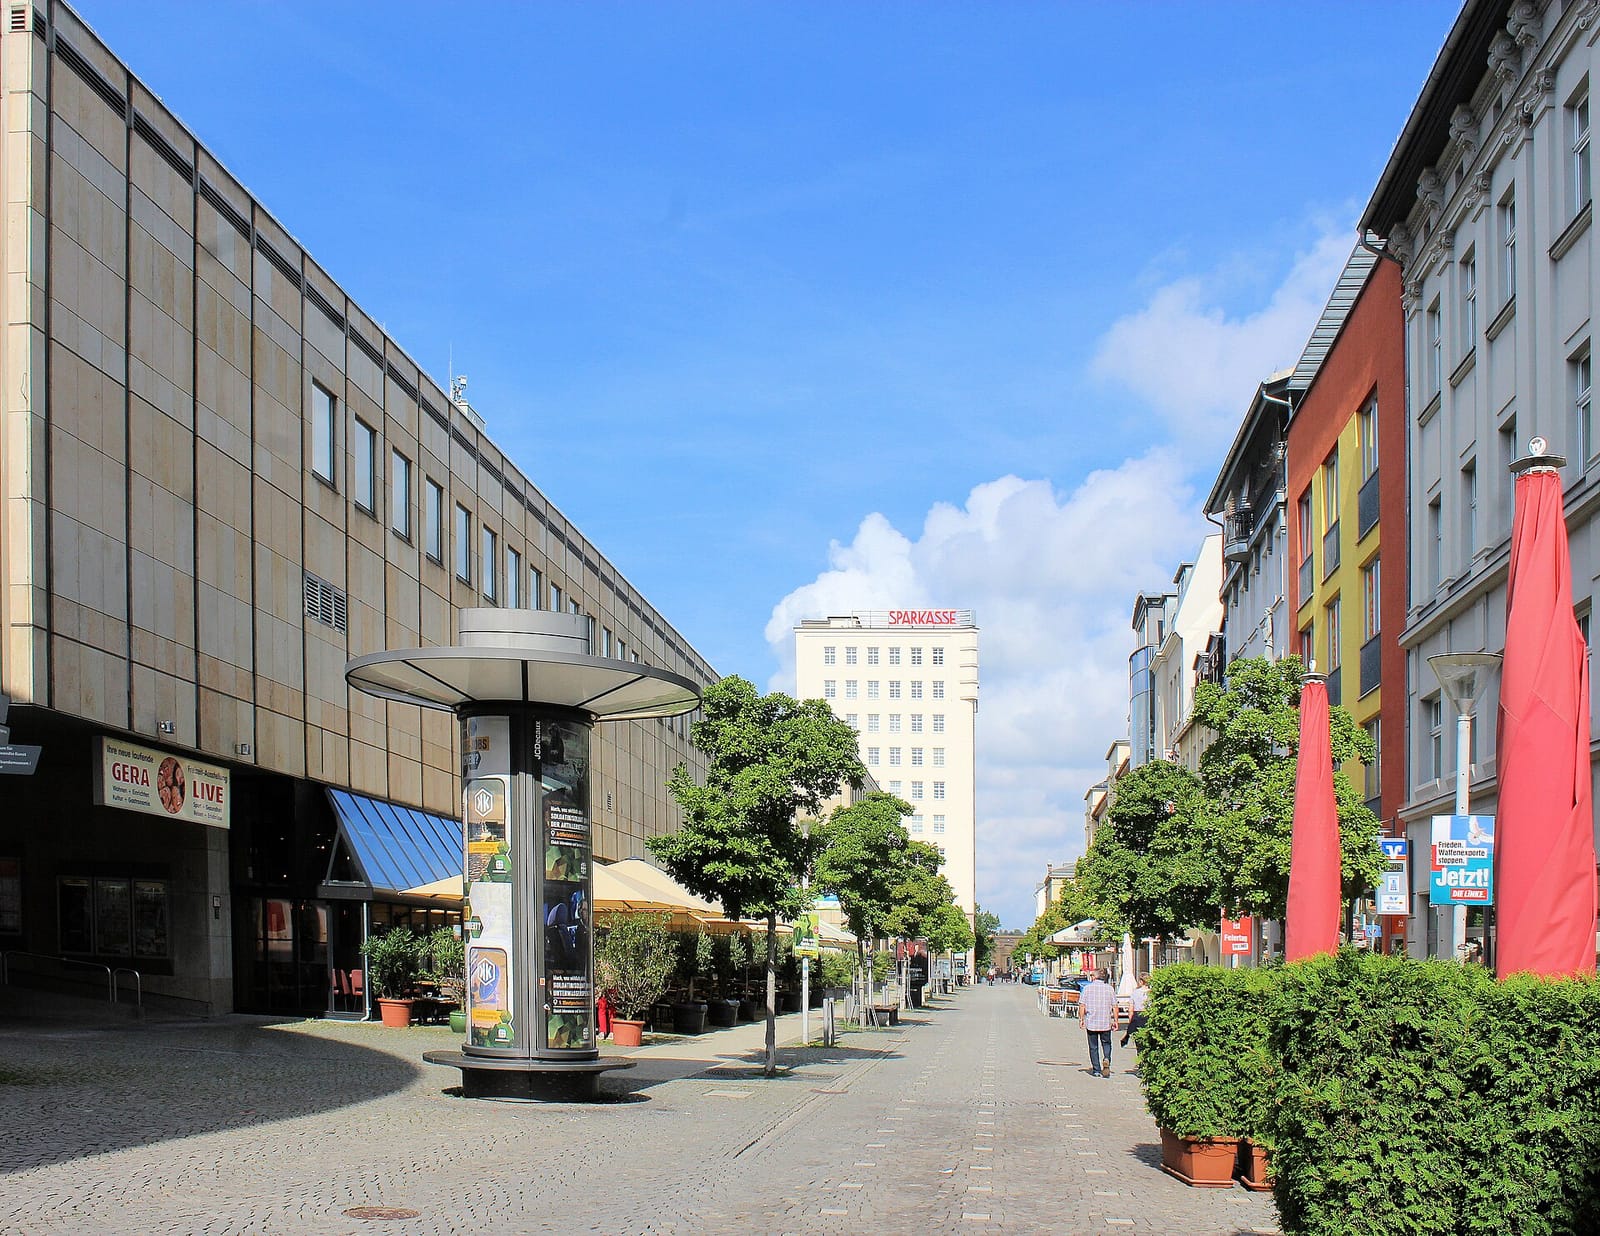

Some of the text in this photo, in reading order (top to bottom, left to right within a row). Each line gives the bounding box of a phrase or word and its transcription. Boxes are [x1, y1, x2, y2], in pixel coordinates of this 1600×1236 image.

[888, 610, 957, 625] SPARKASSE
[111, 762, 150, 787] GERA
[192, 780, 224, 804] LIVE
[1438, 841, 1464, 849] Frieden.
[1438, 849, 1486, 857] Waffenexporte
[1438, 857, 1465, 865] stoppen.
[1435, 867, 1489, 887] Jetzt!
[1452, 889, 1464, 898] DIE
[1224, 934, 1247, 942] Feiertag
